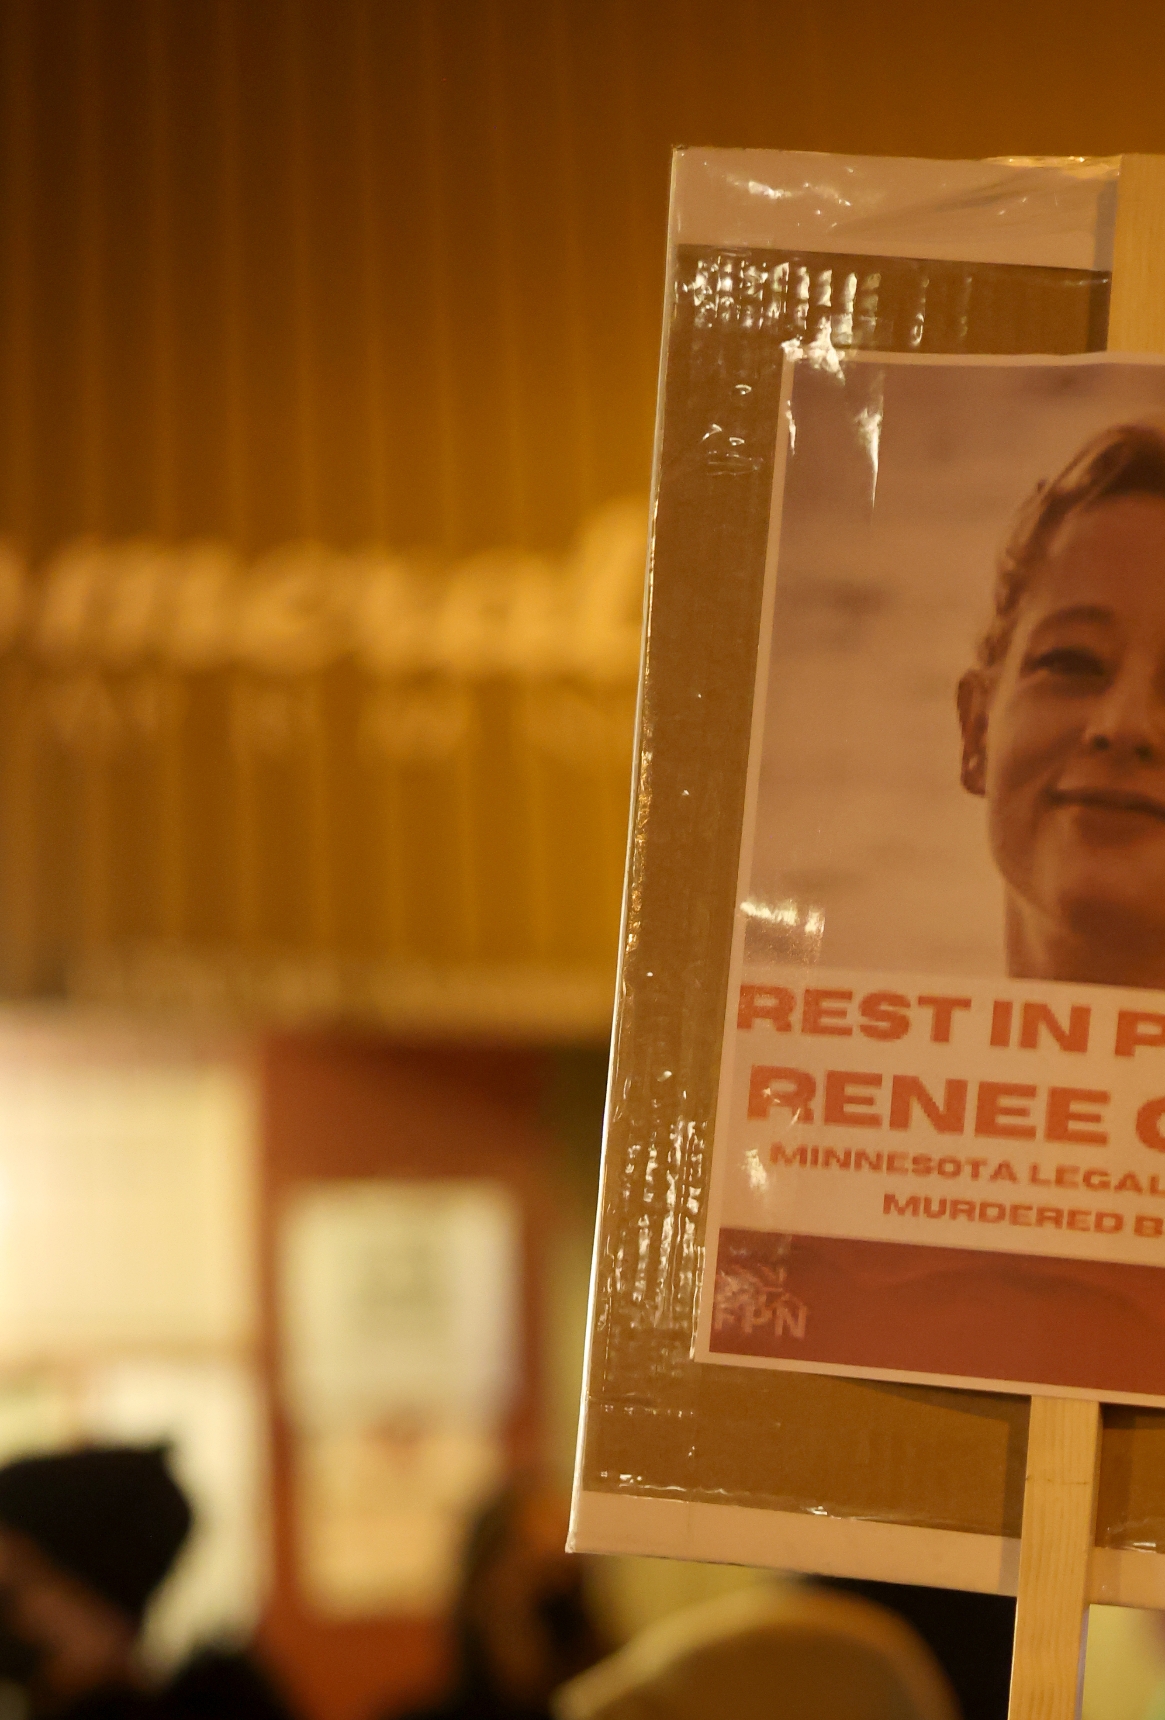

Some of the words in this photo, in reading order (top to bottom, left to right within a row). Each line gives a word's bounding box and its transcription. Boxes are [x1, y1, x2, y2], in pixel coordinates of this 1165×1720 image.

[737, 984, 972, 1042] REST
[989, 998, 1092, 1054] IN
[747, 1064, 1110, 1146] RENEE
[770, 1141, 1019, 1183] MINNESOTA
[883, 1193, 1125, 1235] MURDERED
